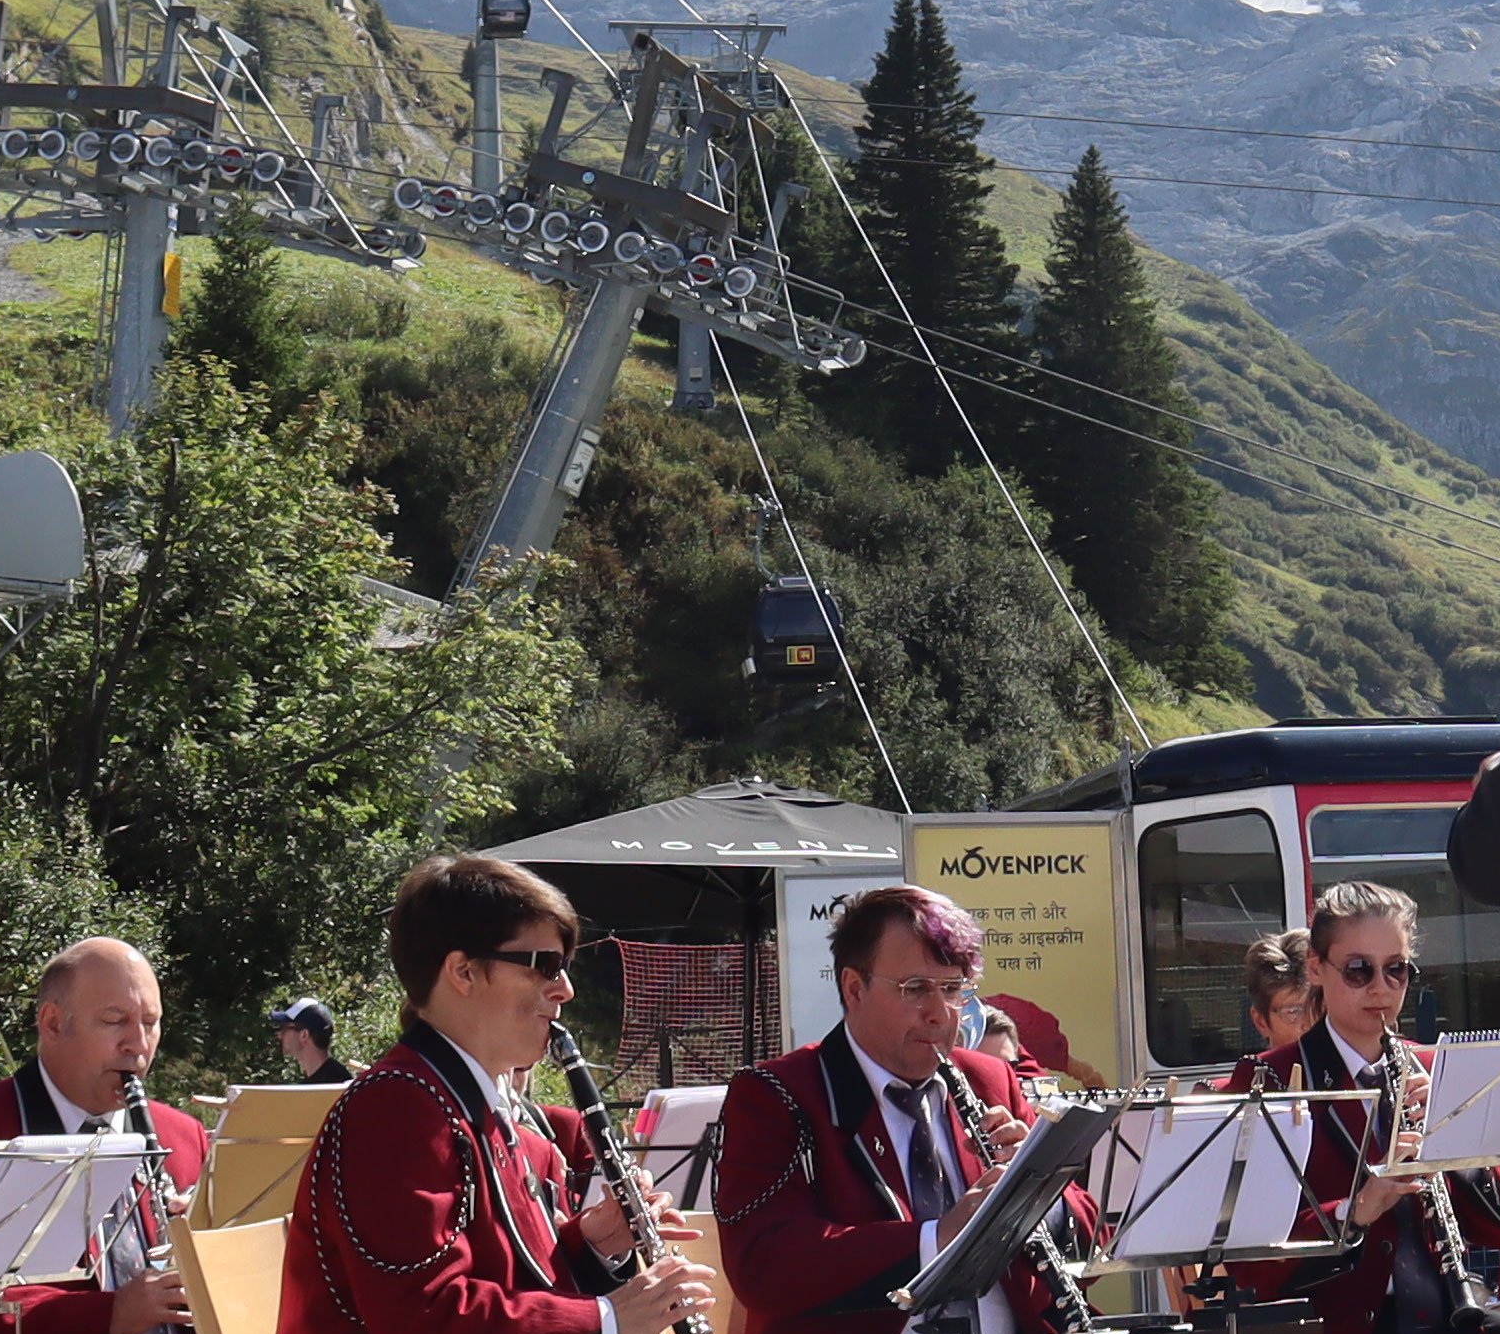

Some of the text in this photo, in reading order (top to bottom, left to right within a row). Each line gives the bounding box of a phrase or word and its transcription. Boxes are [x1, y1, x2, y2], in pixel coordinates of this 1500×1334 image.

[1019, 902, 1036, 920] लो
[1043, 900, 1067, 920] और
[1025, 952, 1042, 970] लो
